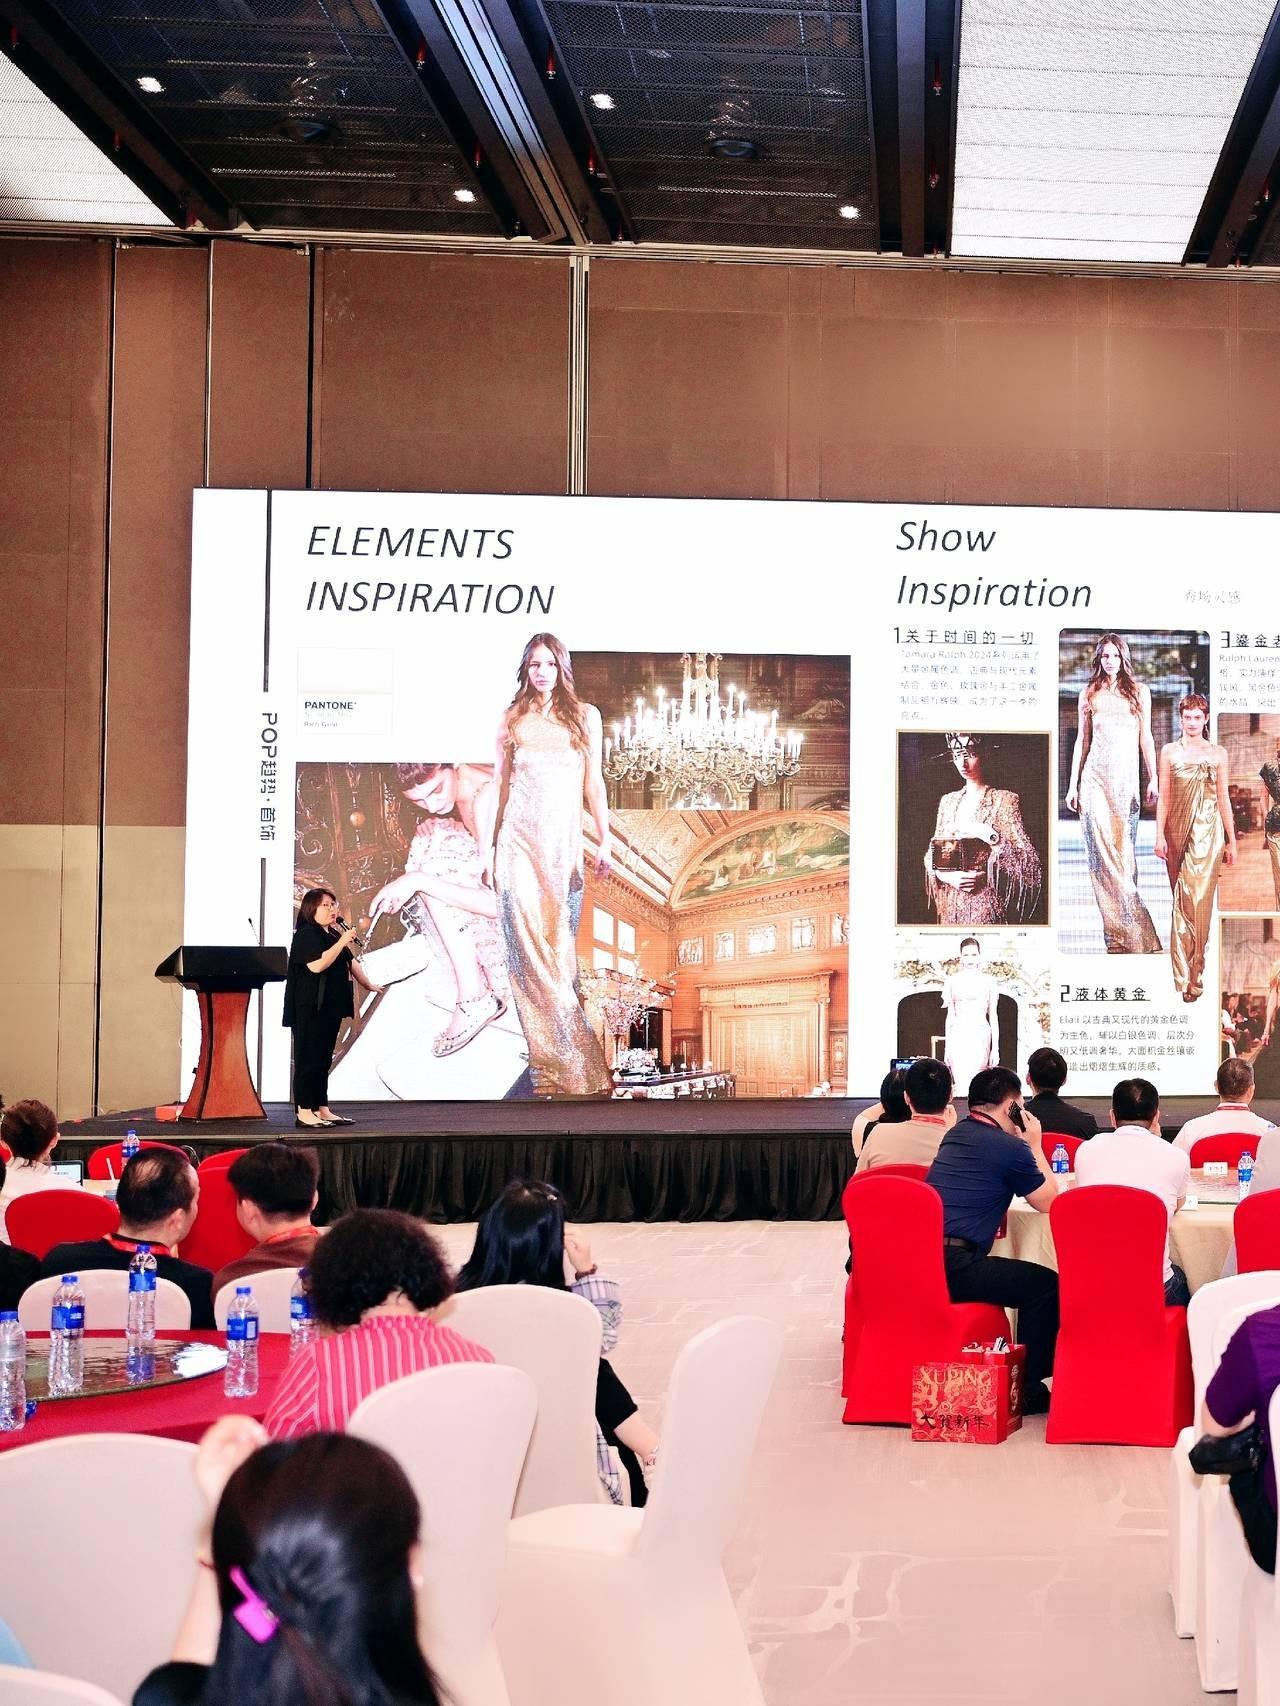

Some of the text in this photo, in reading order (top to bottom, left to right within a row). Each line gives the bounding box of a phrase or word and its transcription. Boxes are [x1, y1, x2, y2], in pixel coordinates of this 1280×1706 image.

[308, 527, 514, 559] ELEMENTS
[897, 520, 996, 551] Show
[307, 582, 554, 614] INSPIRATION
[898, 576, 1091, 612] Inspiration
